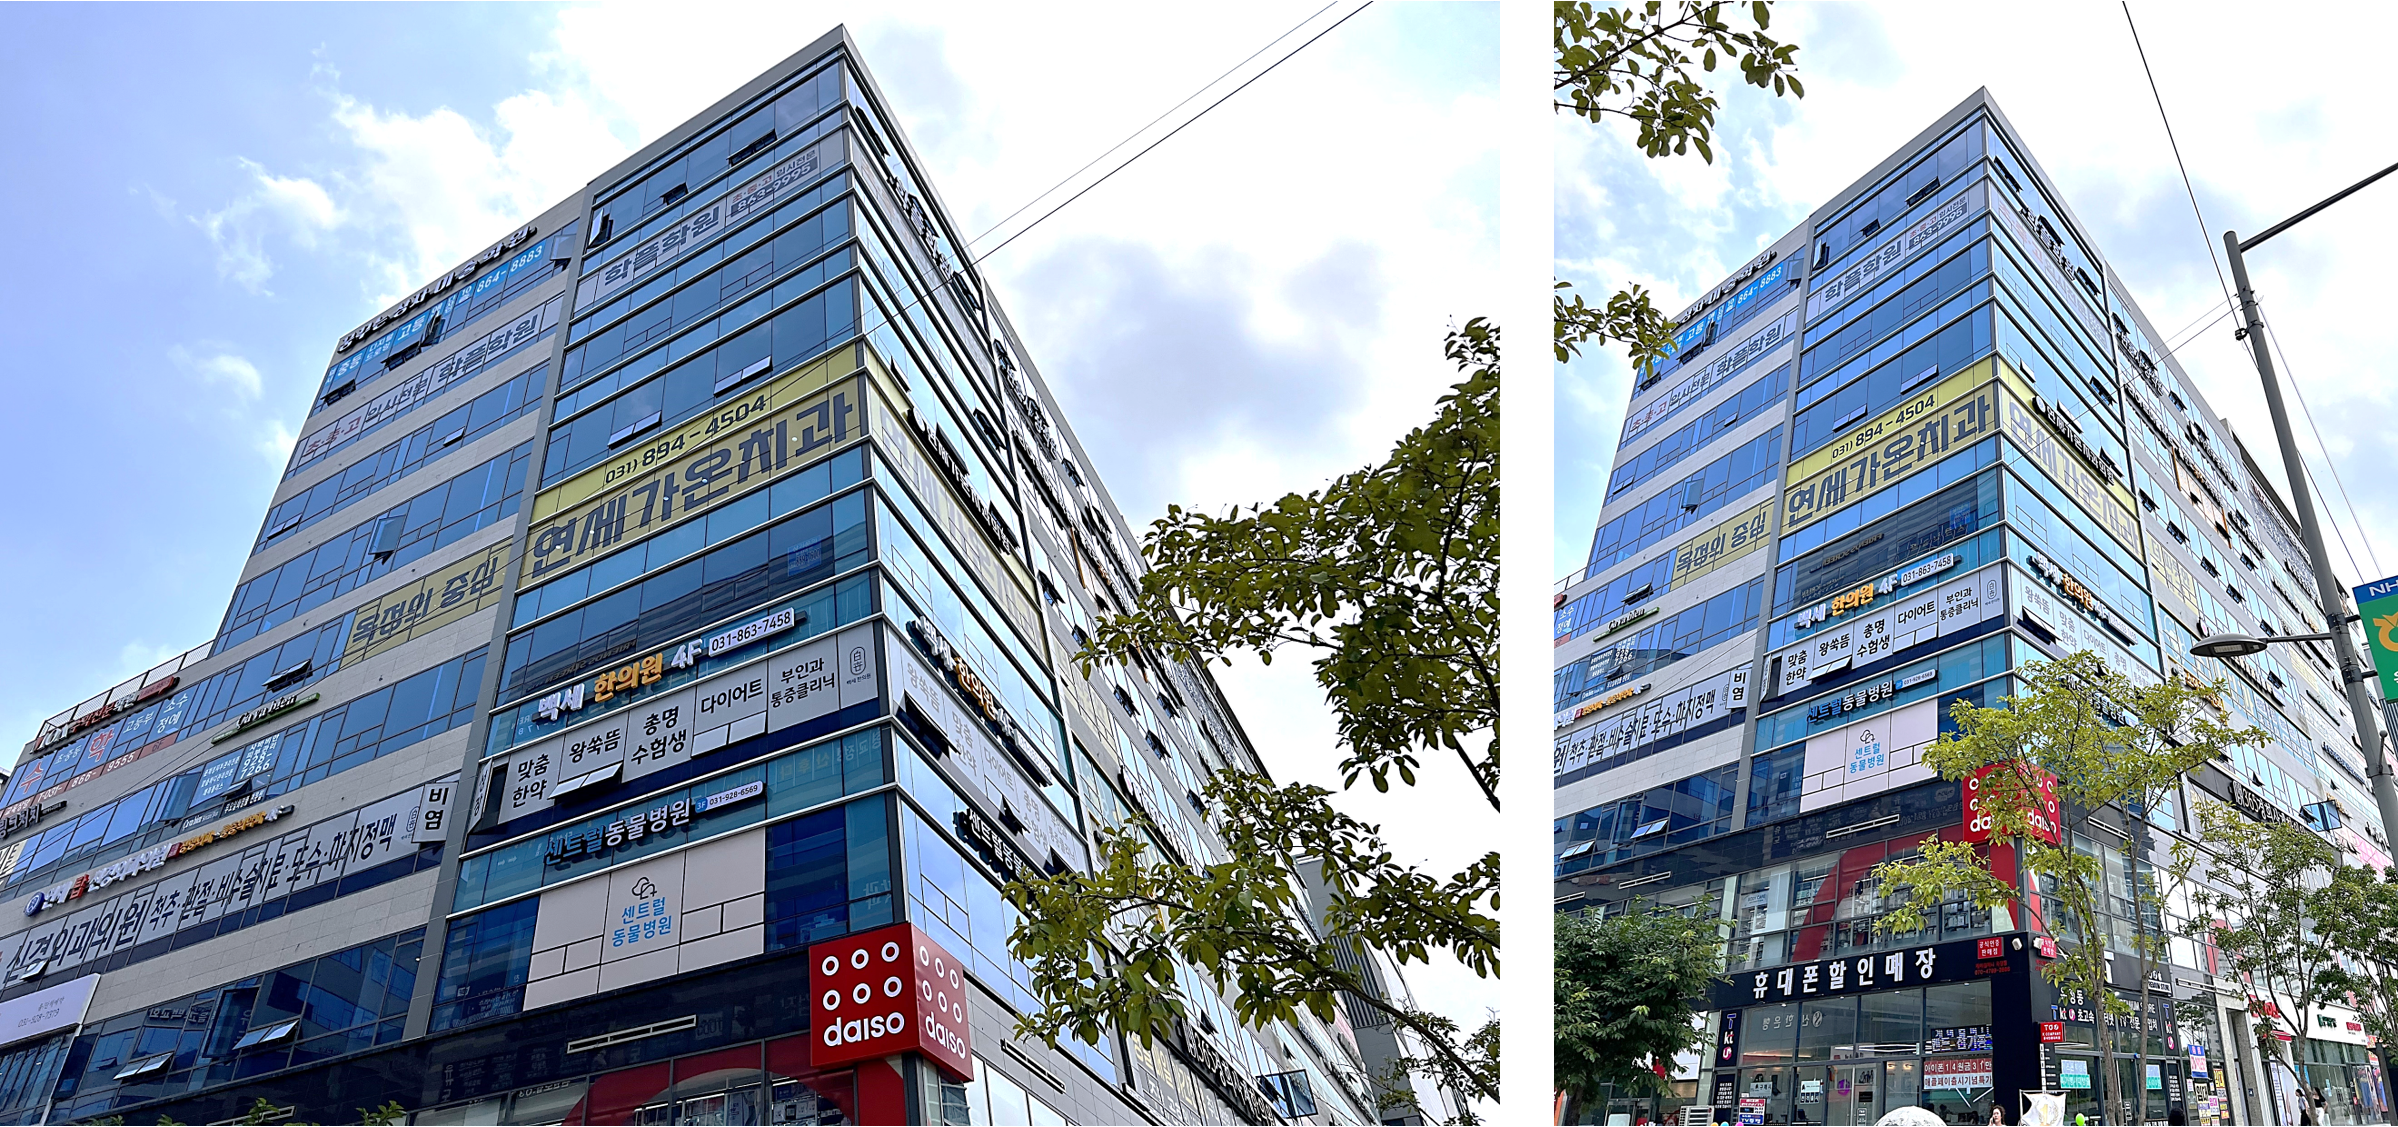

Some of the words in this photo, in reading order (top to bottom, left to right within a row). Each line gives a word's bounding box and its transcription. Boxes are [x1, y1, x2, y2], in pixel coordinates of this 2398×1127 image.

[737, 163, 812, 212] 863-9995
[397, 315, 426, 341] 고등
[605, 458, 639, 486] 031)
[642, 395, 767, 467] 894-4504
[1832, 441, 1854, 460] 031)
[1855, 394, 1936, 446] 894-4504
[1788, 394, 1990, 528] 연세가온치과
[531, 391, 854, 579] 연세가온치과
[1731, 510, 1767, 542] 중심
[439, 555, 499, 597] 중심
[1831, 583, 1875, 616] 한의원
[1879, 574, 1899, 595] 4F
[1902, 556, 1952, 585] 031-863-7458
[2062, 572, 2094, 612] 한의원
[1897, 600, 1937, 626] 다이어트
[1939, 597, 1980, 622] 통증클리닉
[1945, 586, 1973, 606] 부인과
[1856, 634, 1892, 660] 수험생
[1863, 618, 1886, 640] 총명
[592, 652, 665, 702] 한의원
[669, 639, 703, 671] 4F
[709, 610, 794, 653] 031-863-7458
[780, 655, 826, 686] 부인과
[1787, 652, 1808, 670] 맞춤
[770, 672, 837, 710] 통증클리닉
[954, 656, 997, 722] 한의원
[1732, 672, 1747, 702] 비염
[1785, 666, 1807, 687] 한약
[700, 677, 765, 716] 다이어트
[1806, 680, 1894, 724] 센트럴동물병원
[643, 705, 681, 736] 총명
[88, 727, 115, 763] 학
[569, 726, 623, 764] 왕쑥뜸
[629, 728, 688, 766] 수험생
[1850, 753, 1885, 774] 동물병원
[1854, 742, 1881, 760] 센트럴
[240, 761, 271, 780] 7266
[517, 752, 552, 781] 맞춤
[424, 786, 449, 832] 비염
[511, 777, 549, 809] 한약
[543, 796, 693, 865] 센트럴동물병원
[708, 783, 760, 808] 031-928-6569
[621, 894, 667, 925] 센트럴
[611, 915, 673, 949] 동물병원
[1753, 947, 1936, 999] 휴대폰할인매장
[822, 1010, 905, 1048] daiso
[924, 1013, 967, 1061] daiso
